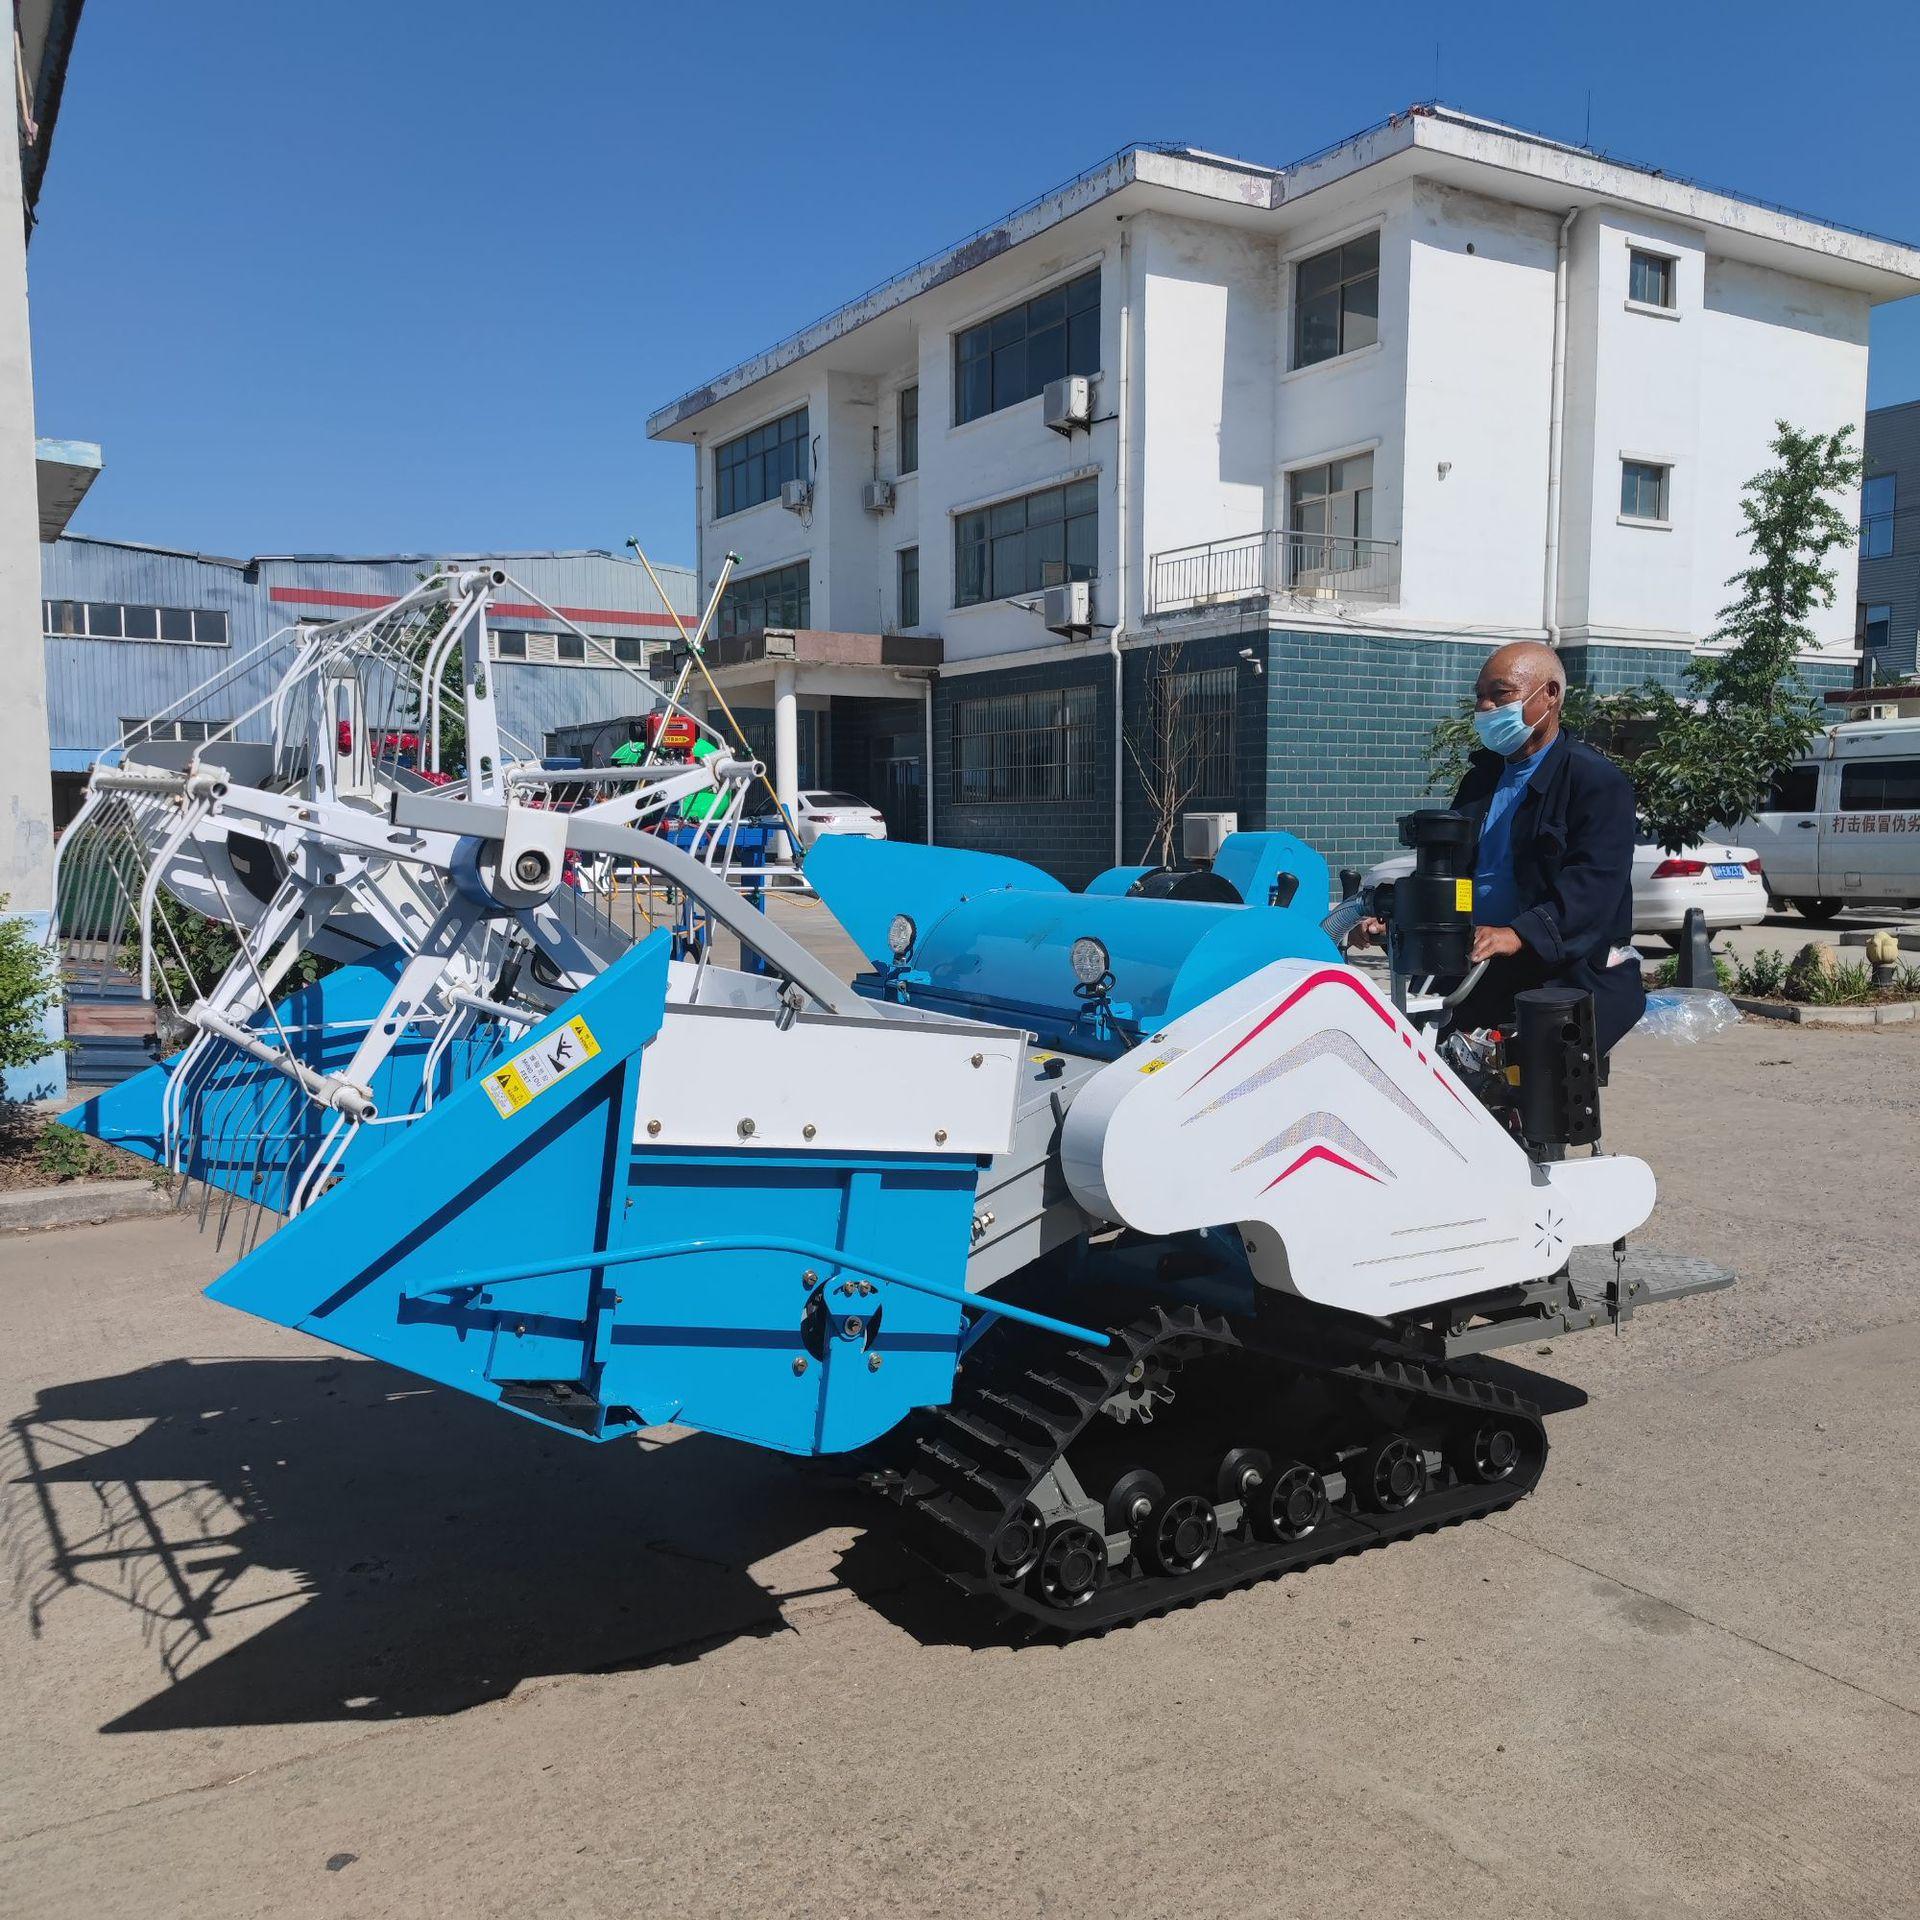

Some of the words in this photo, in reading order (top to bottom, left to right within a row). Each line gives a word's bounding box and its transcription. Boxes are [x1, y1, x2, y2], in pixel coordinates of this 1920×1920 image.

[1832, 815, 1920, 833] 打击假冒伪劣
